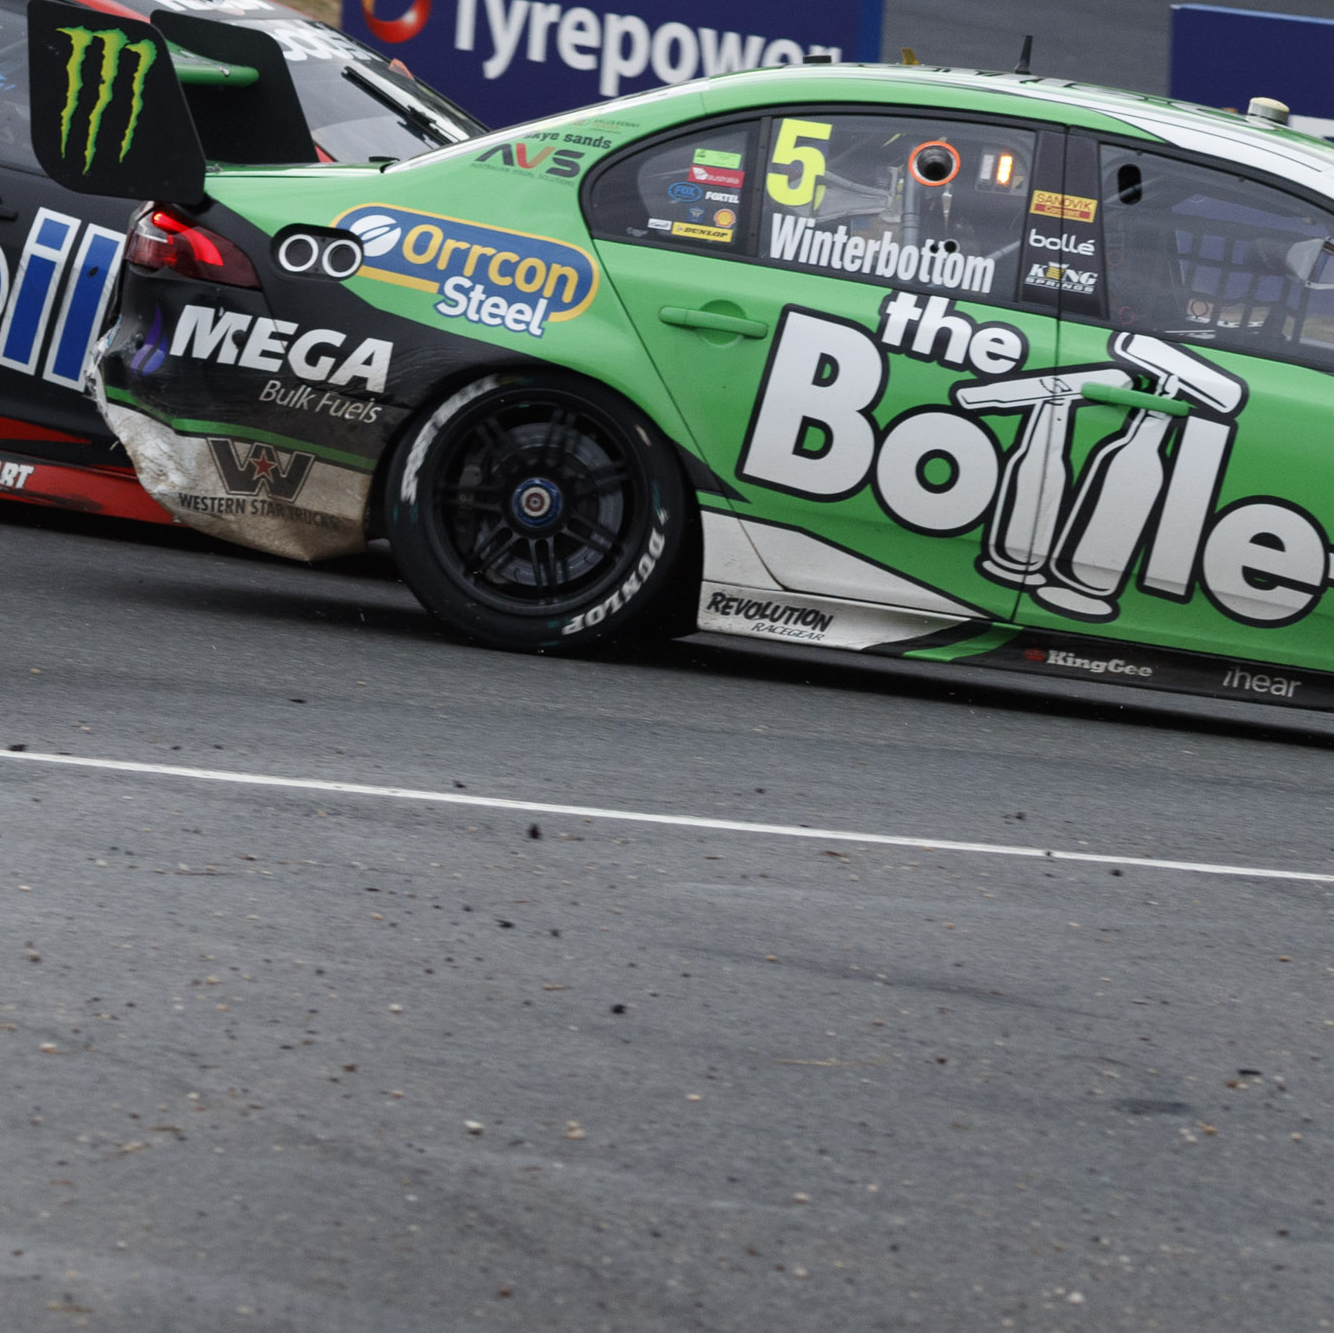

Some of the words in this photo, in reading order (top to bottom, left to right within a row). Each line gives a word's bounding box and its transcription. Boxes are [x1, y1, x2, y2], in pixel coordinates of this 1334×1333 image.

[563, 133, 612, 150] sands
[767, 118, 833, 206] 5
[705, 191, 740, 204] FOXTEL
[1037, 193, 1093, 212] SANDVIK
[684, 226, 729, 239] DUNLOP
[1029, 228, 1096, 256] bollé
[402, 224, 579, 303] Orrcon
[769, 213, 996, 294] Winterbottom
[435, 275, 548, 336] Steel
[169, 304, 394, 393] MEGA
[878, 291, 1027, 377] the
[259, 380, 317, 411] Bulk
[316, 392, 383, 423] Fuels
[178, 492, 246, 516] WESTERN
[250, 498, 285, 518] STAR
[706, 591, 834, 631] REVOLUTION
[751, 619, 826, 642] RACEGEAR
[1045, 648, 1154, 678] KingGee
[1221, 667, 1302, 699] ihear
